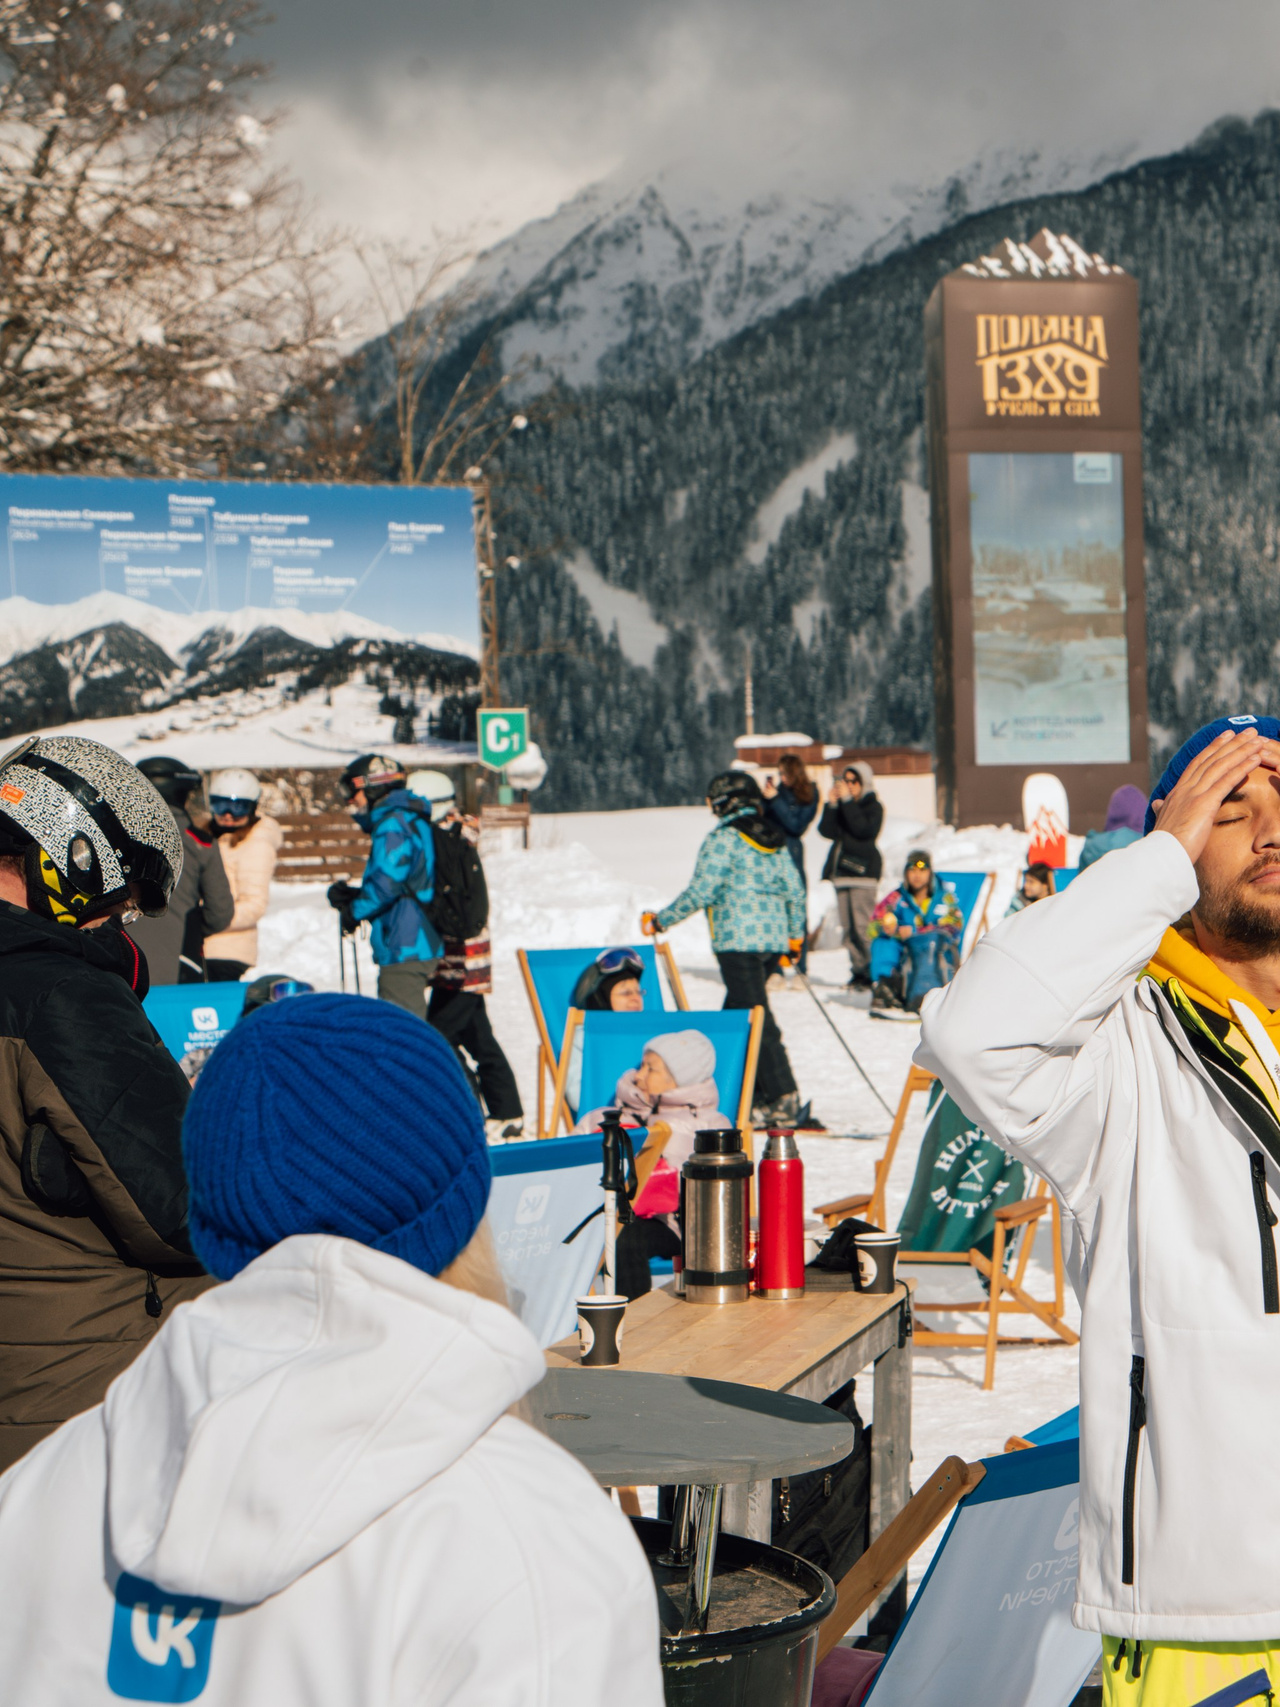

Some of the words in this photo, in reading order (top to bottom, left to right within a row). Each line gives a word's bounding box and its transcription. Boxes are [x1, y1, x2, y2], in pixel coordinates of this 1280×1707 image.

[976, 314, 1109, 360] ПОЛЯНА
[978, 347, 1101, 401] 1389
[131, 1603, 204, 1669] VK
